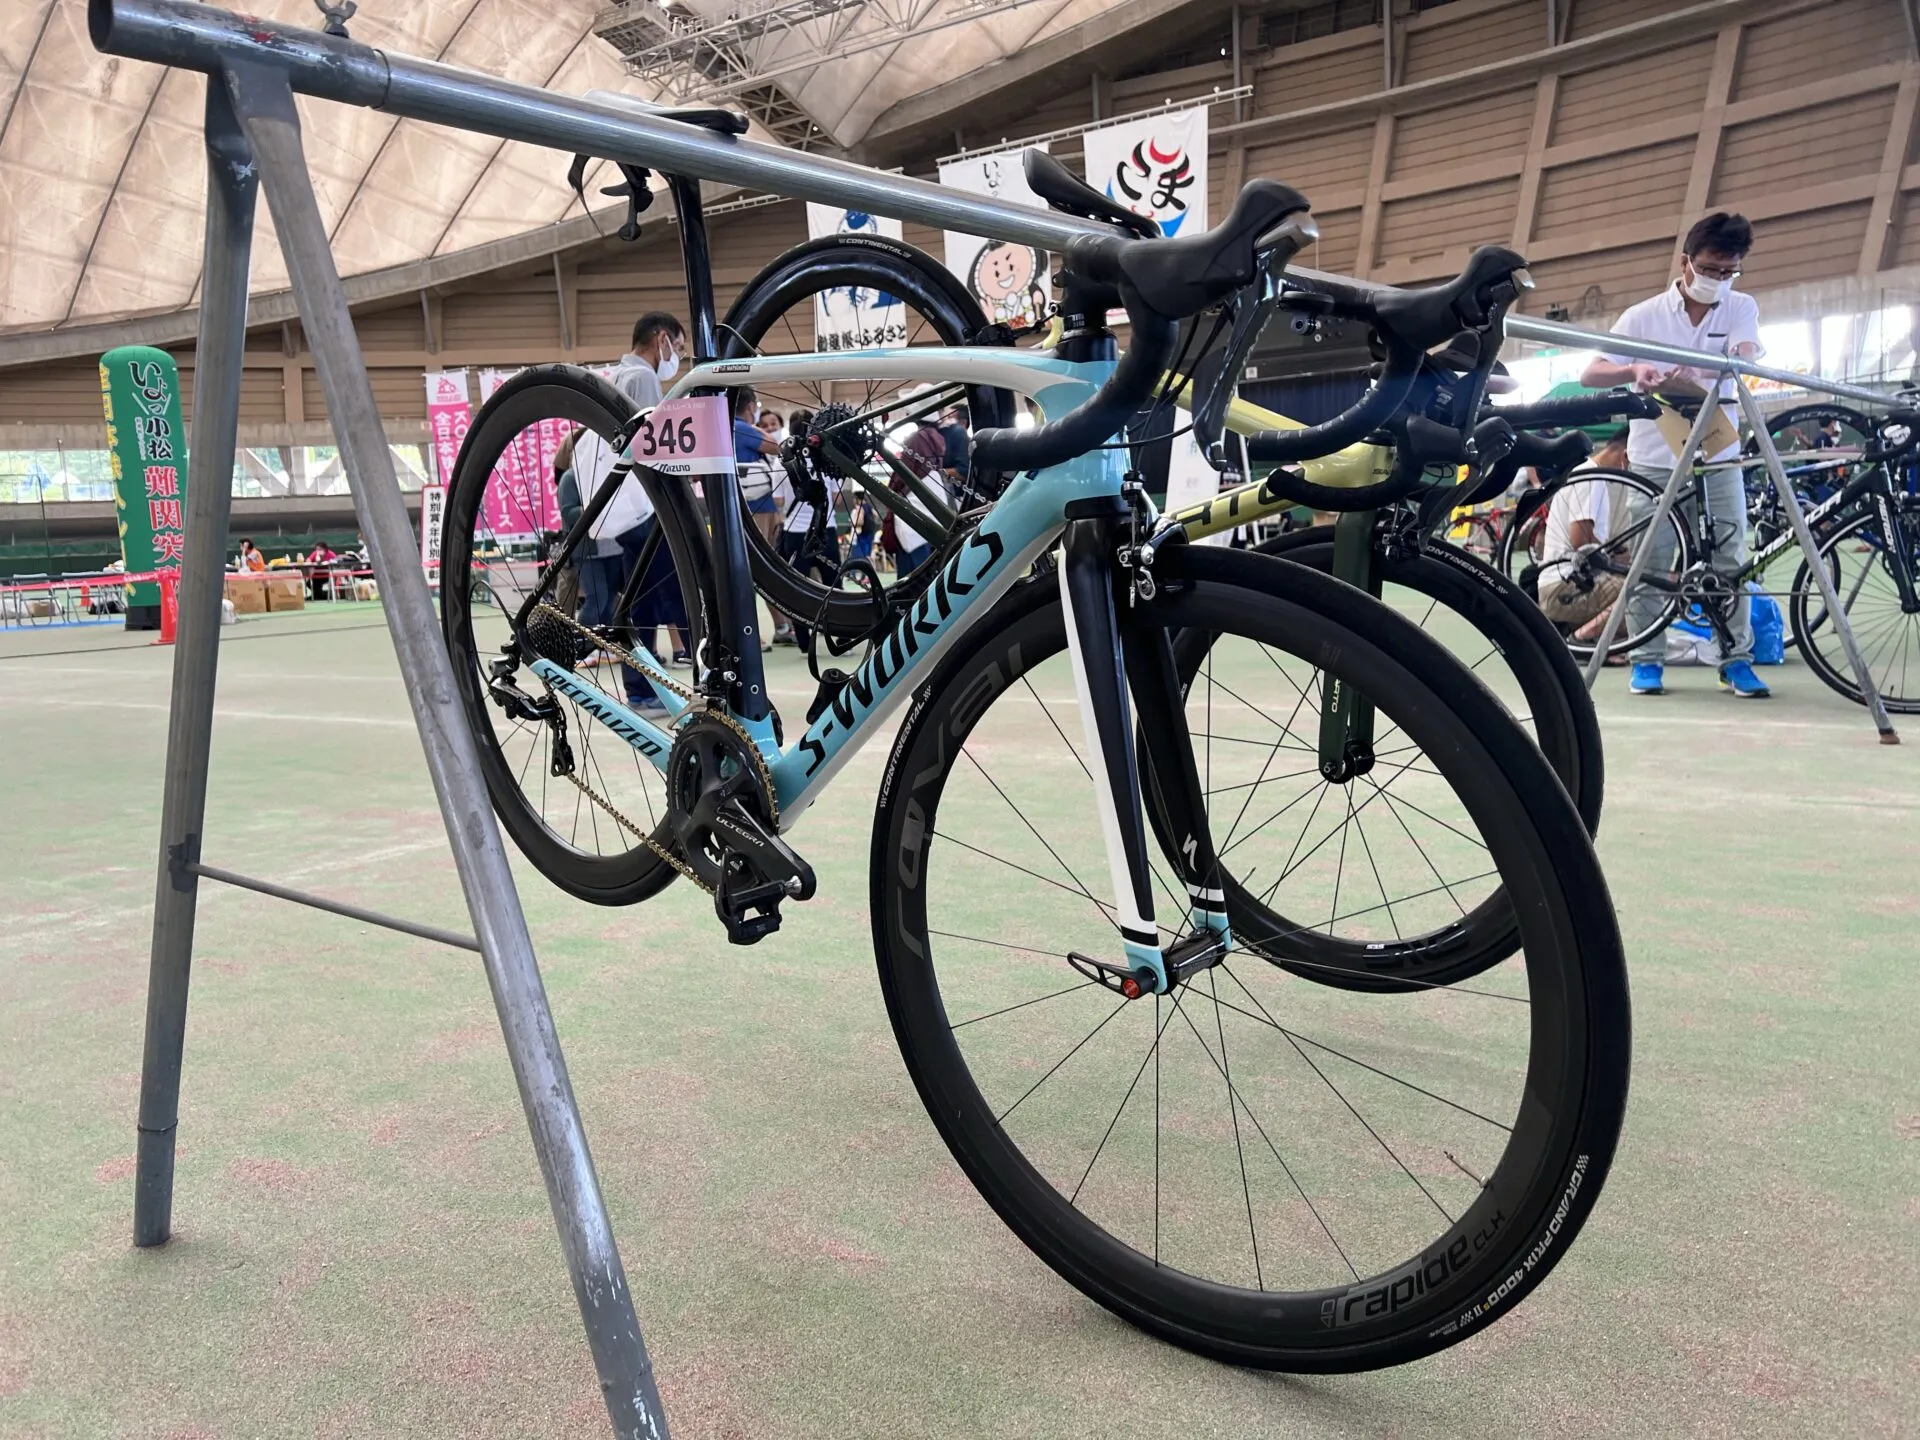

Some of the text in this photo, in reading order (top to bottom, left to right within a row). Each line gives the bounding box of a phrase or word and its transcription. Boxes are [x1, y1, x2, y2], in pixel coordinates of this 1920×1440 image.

[845, 237, 903, 256] CONTINENTAL
[641, 416, 697, 456] 346
[429, 491, 441, 579] 特別賞・年代別彰
[1425, 545, 1496, 588] ONTINENTAL
[799, 530, 1004, 778] S-WORKS
[543, 667, 663, 757] SPECIALIZED
[883, 701, 925, 796] CONTINENTAL
[716, 816, 765, 847] ULTEGRA
[1342, 1233, 1474, 1323] rapide
[1487, 1267, 1525, 1307] 4000
